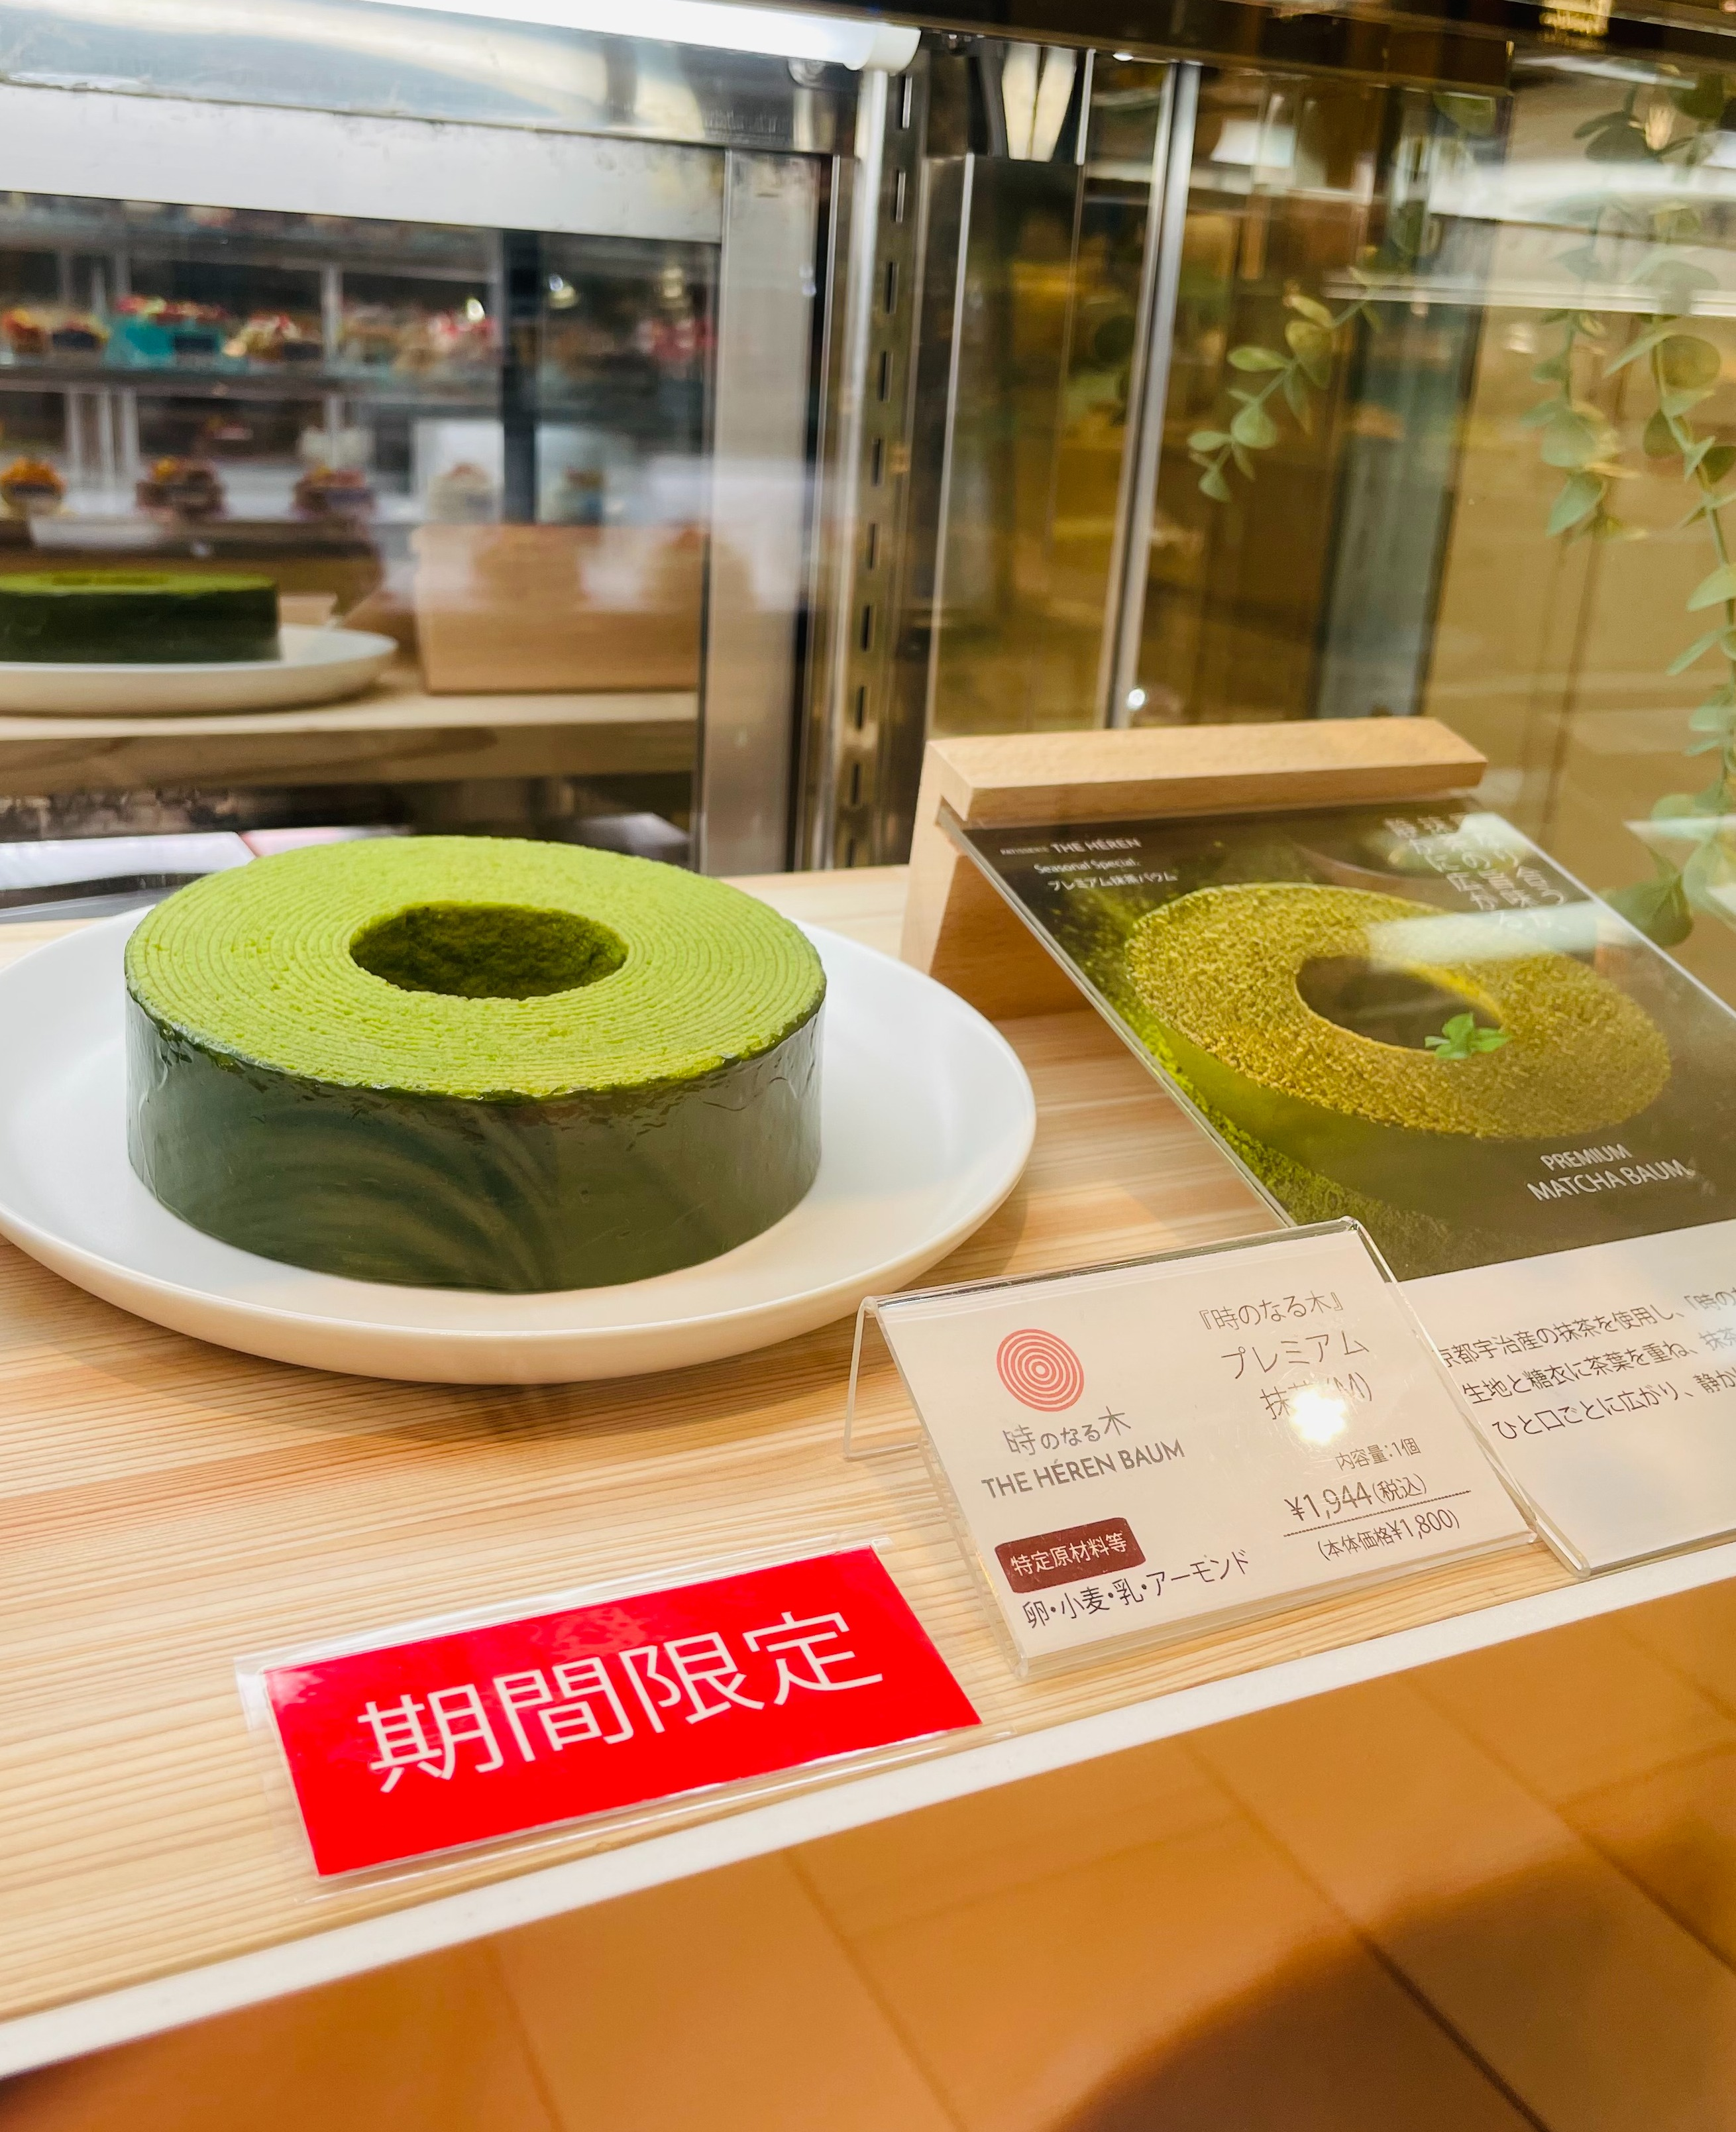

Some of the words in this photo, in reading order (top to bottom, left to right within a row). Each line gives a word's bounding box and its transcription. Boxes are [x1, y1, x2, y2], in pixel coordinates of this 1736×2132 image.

[1033, 861, 1091, 874] Seasonal
[1050, 840, 1086, 854] THE
[1540, 1143, 1633, 1172] PREMIUM
[1527, 1170, 1627, 1201] MATCHA
[1199, 1290, 1344, 1331] 『時のなる木』
[1221, 1329, 1370, 1379] プレミアム
[1260, 1372, 1373, 1420] 抹M)
[1002, 1405, 1132, 1457] 時のなる木
[981, 1471, 1033, 1499] THE
[1033, 1453, 1118, 1488] HÉREN
[1118, 1438, 1185, 1470] BAUM
[1283, 1473, 1427, 1522] ¥1,944(税込)
[1010, 1532, 1128, 1577] 特定原材料等
[1317, 1508, 1460, 1561] (本体価格¥1,800)
[1022, 1548, 1249, 1629] 卵・小麦・乳・アーモンド
[356, 1609, 884, 1794] 期間限定
